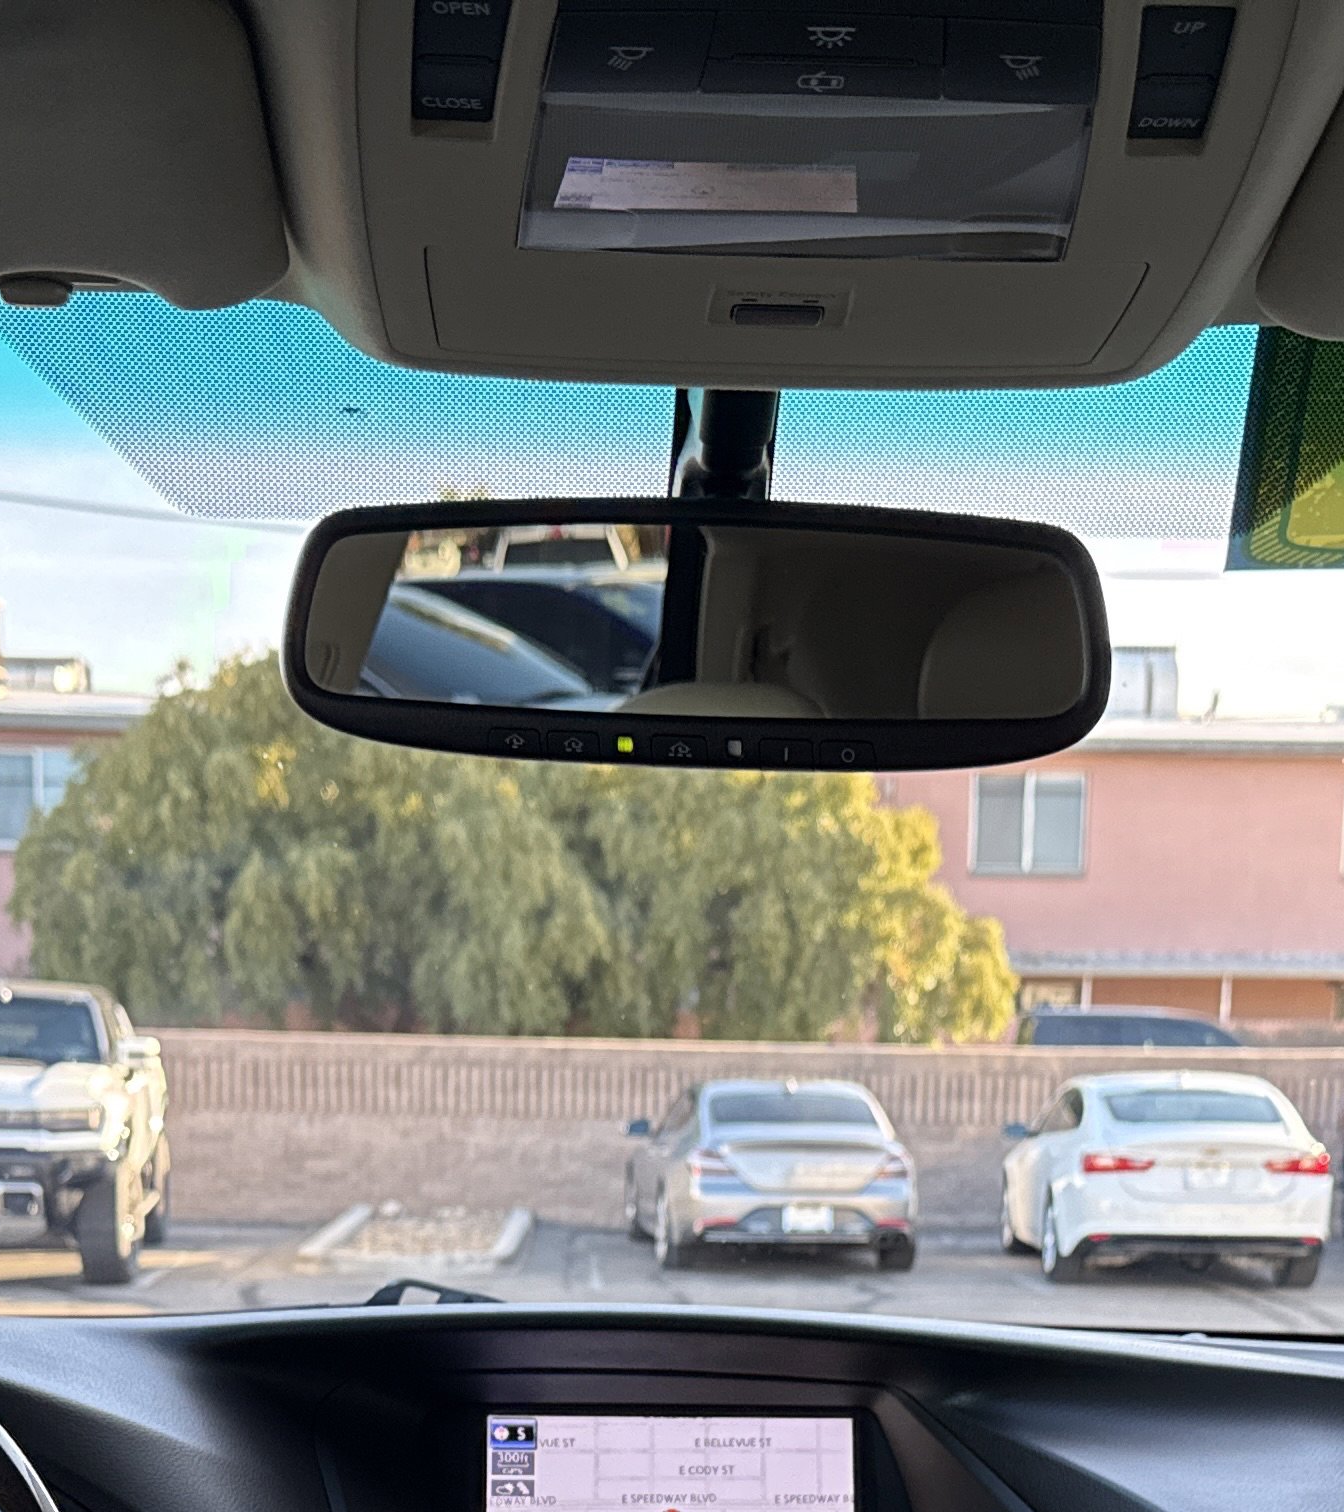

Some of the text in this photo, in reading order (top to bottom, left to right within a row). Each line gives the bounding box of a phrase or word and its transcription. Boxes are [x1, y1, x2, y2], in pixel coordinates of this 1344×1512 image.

[432, 1, 490, 15] OPEN
[1174, 21, 1207, 34] UP
[421, 96, 485, 110] CLOSE
[1138, 117, 1202, 128] DOWN
[516, 1427, 526, 1440] S
[563, 1438, 575, 1448] ST
[704, 1438, 756, 1447] BELLEVUE
[759, 1438, 772, 1447] ST
[688, 1465, 719, 1476] CODY
[722, 1465, 735, 1475] ST
[531, 1495, 557, 1506] BLVD
[630, 1493, 687, 1504] SPEEDWAY
[690, 1493, 717, 1503] BLVD
[783, 1494, 840, 1504] SPEEDWAY
